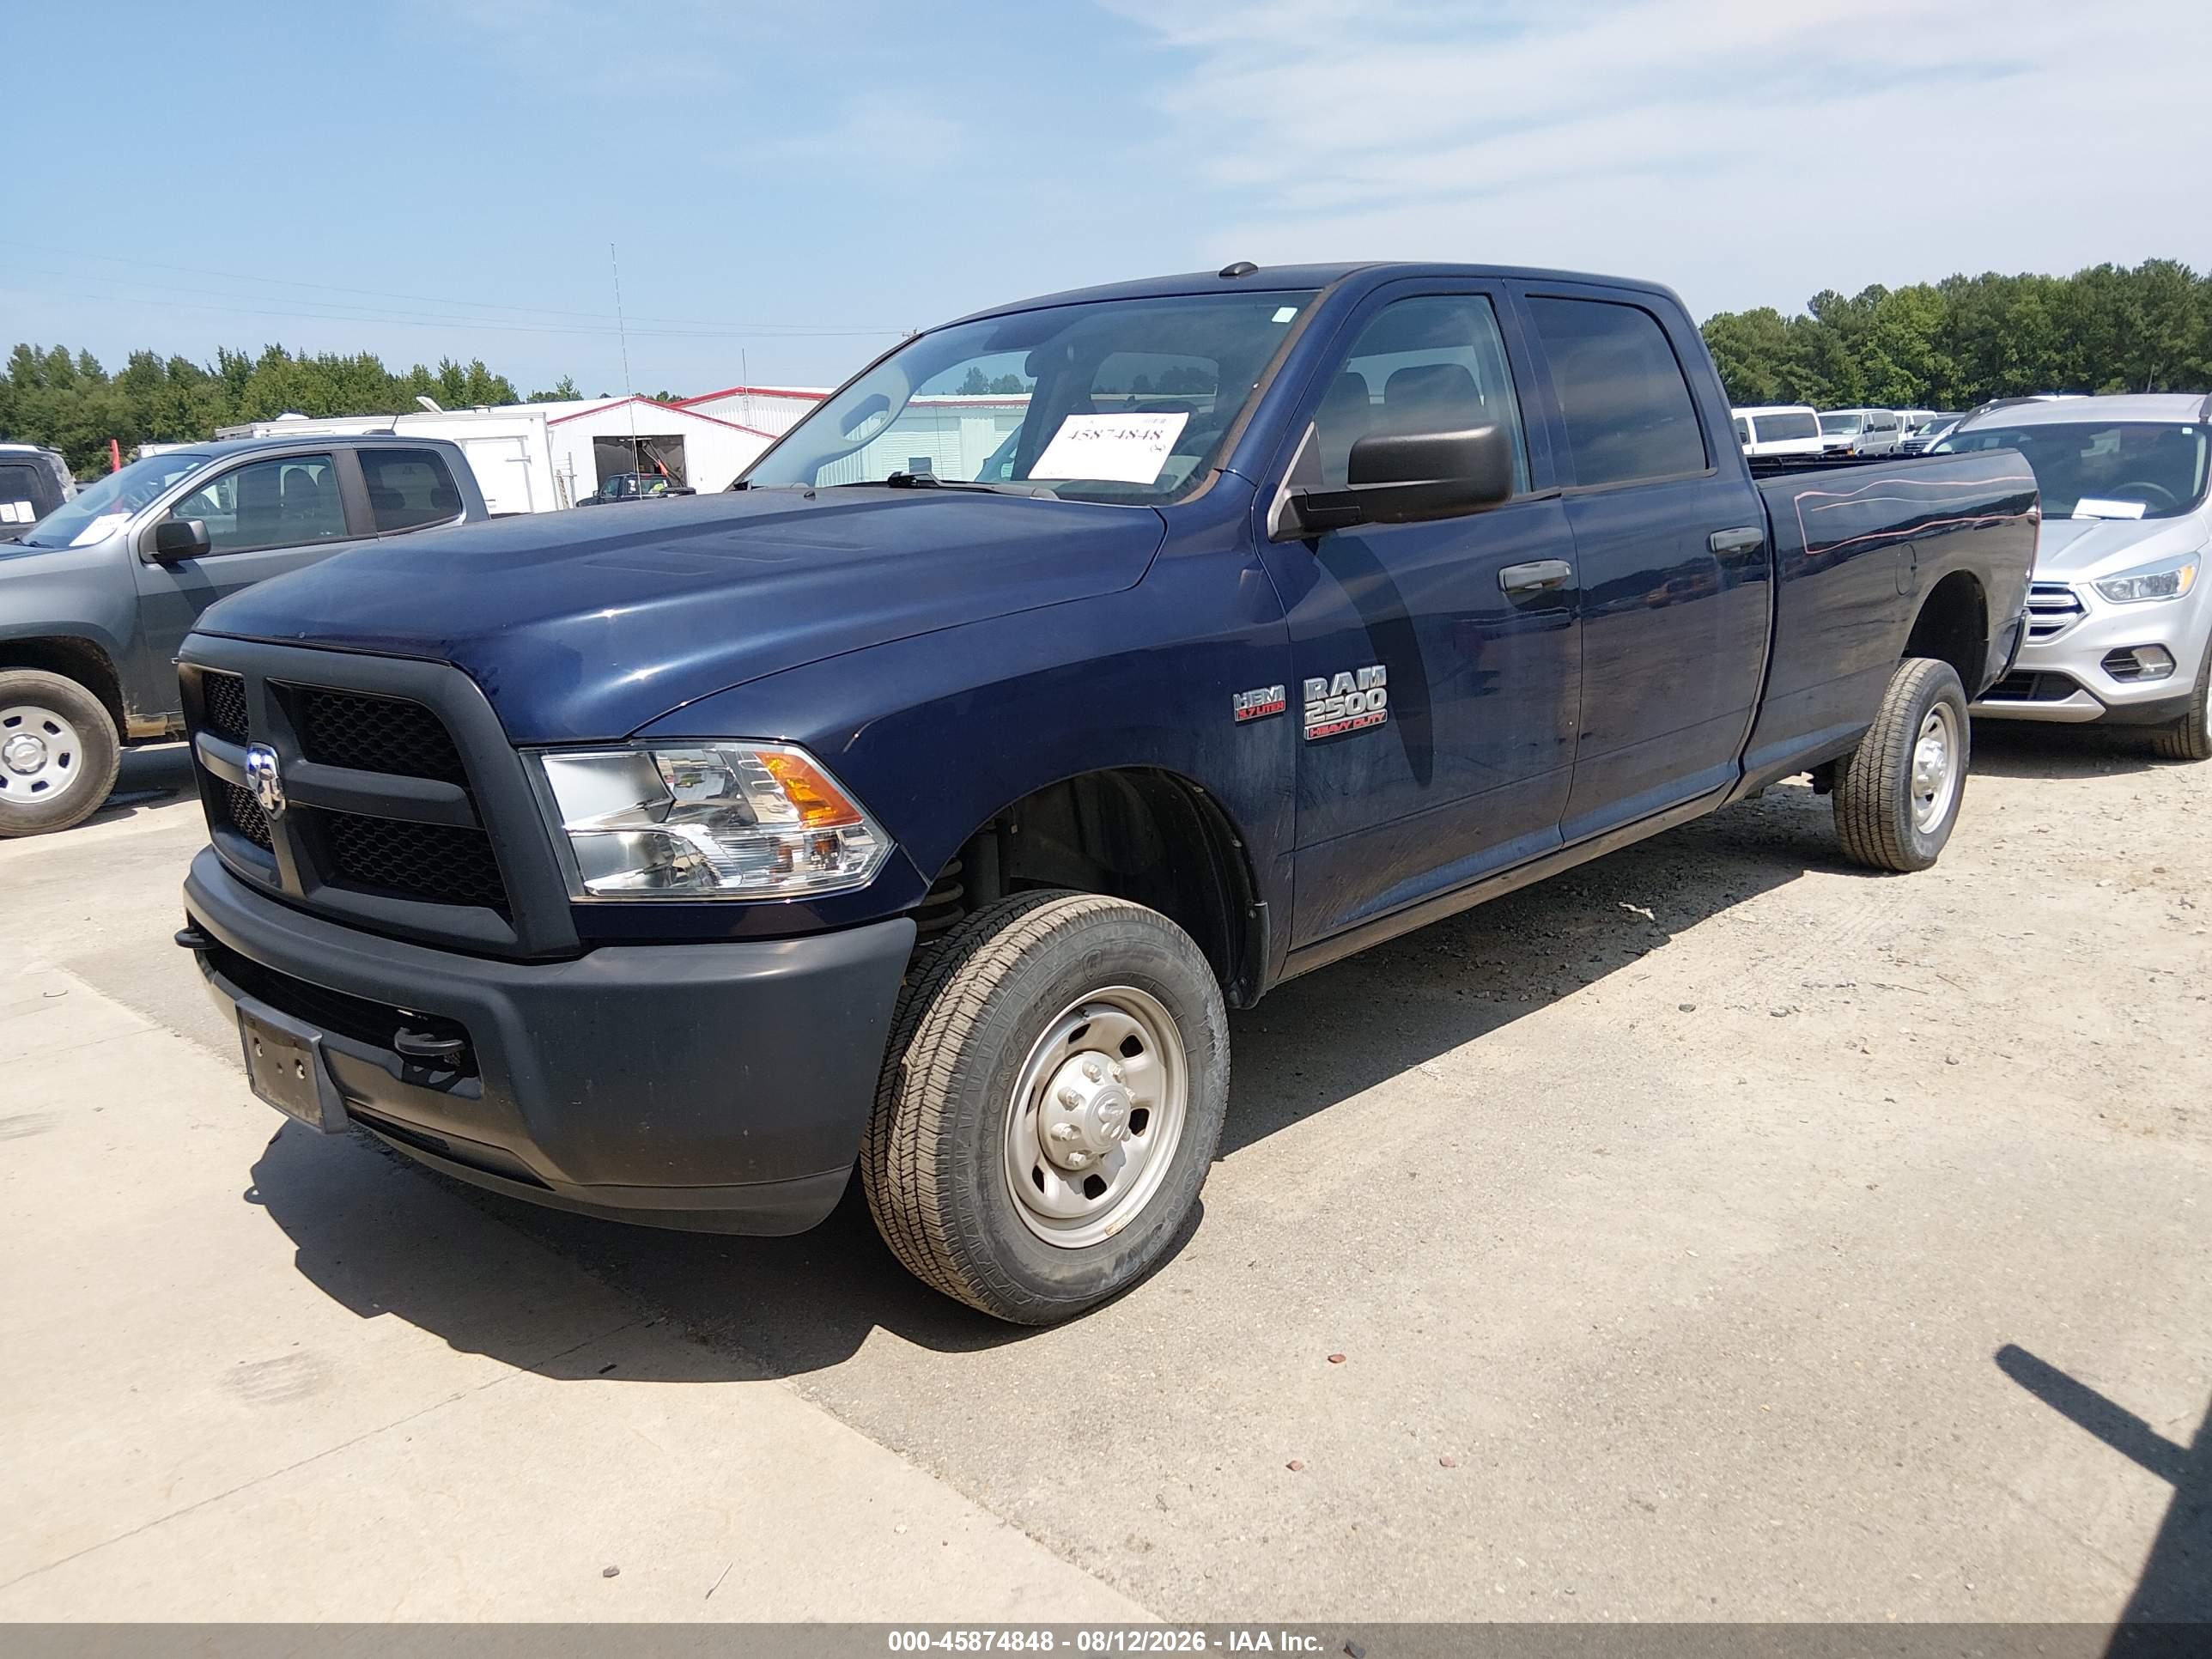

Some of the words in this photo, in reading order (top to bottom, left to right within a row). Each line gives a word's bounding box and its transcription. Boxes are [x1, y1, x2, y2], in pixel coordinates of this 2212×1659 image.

[1067, 428, 1164, 441] 45874848
[1304, 665, 1387, 702] RAM
[1304, 688, 1388, 725] 2500
[1310, 720, 1352, 738] HEAVY
[1353, 712, 1385, 729] DUTY
